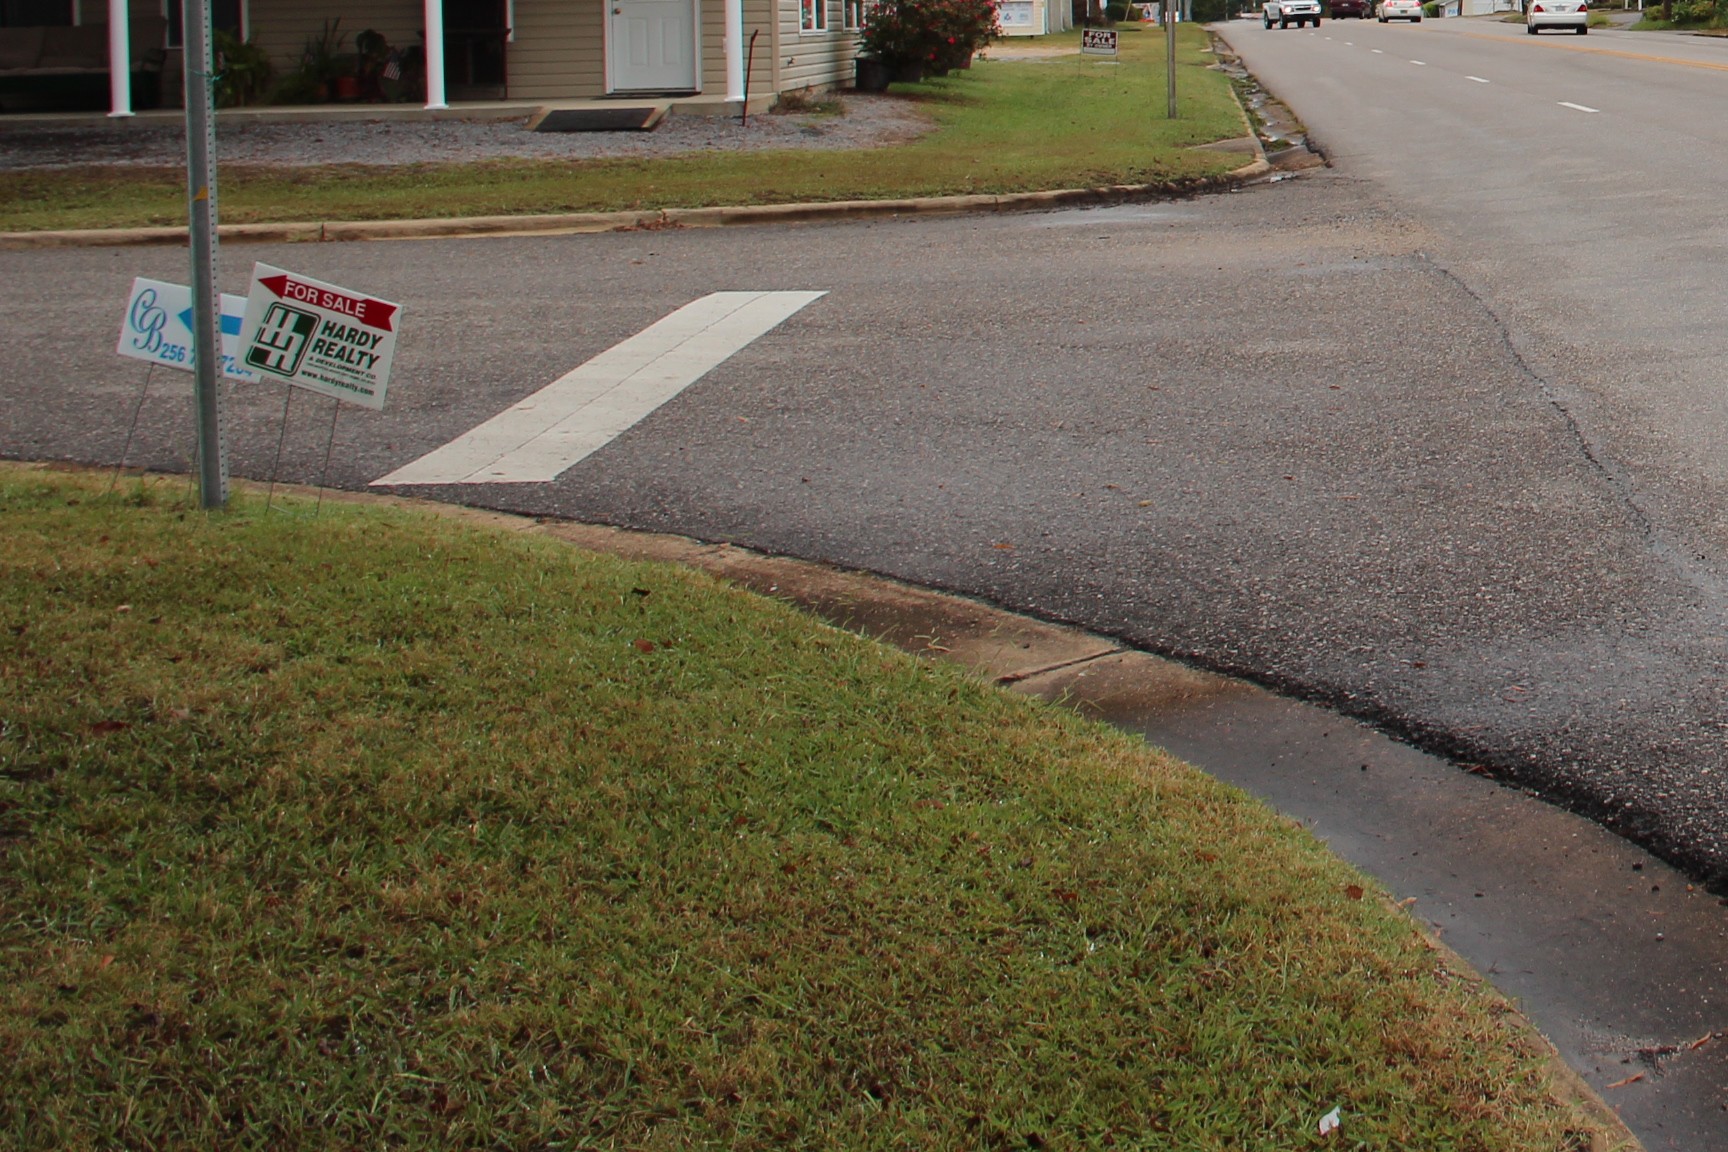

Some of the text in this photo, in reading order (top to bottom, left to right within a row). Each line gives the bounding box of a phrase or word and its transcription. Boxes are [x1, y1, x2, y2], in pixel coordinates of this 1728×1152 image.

[1084, 36, 1115, 45] SALE
[1089, 31, 1111, 39] FOR
[284, 281, 367, 318] FOR SALE
[320, 320, 384, 349] HARDY
[160, 343, 187, 363] 256
[311, 338, 381, 369] REALTY
[315, 357, 365, 376] DEVELOPMENT
[301, 369, 375, 396] www.hardyrealty.com
